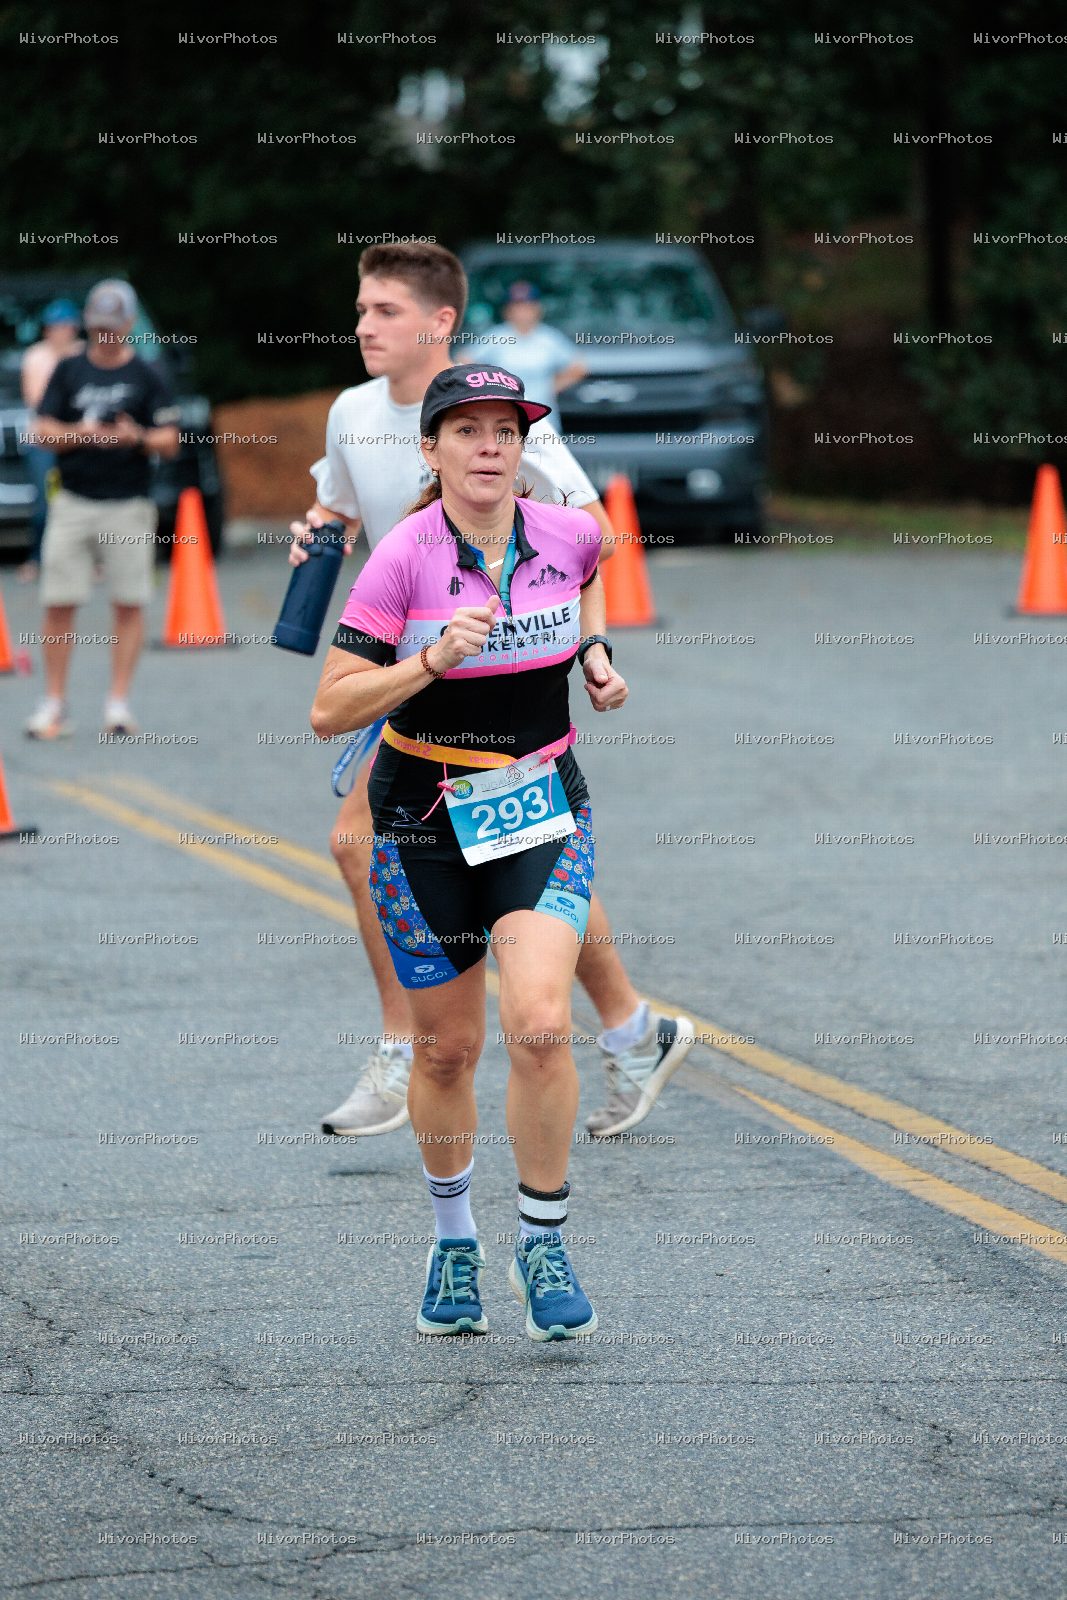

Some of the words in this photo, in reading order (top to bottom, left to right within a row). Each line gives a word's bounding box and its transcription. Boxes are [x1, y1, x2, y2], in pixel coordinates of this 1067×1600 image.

[466, 371, 519, 391] guts
[440, 607, 571, 638] ENVILLE
[516, 637, 526, 649] &
[531, 630, 557, 646] TRI
[471, 785, 549, 840] 293
[410, 971, 448, 983] SUGOI
